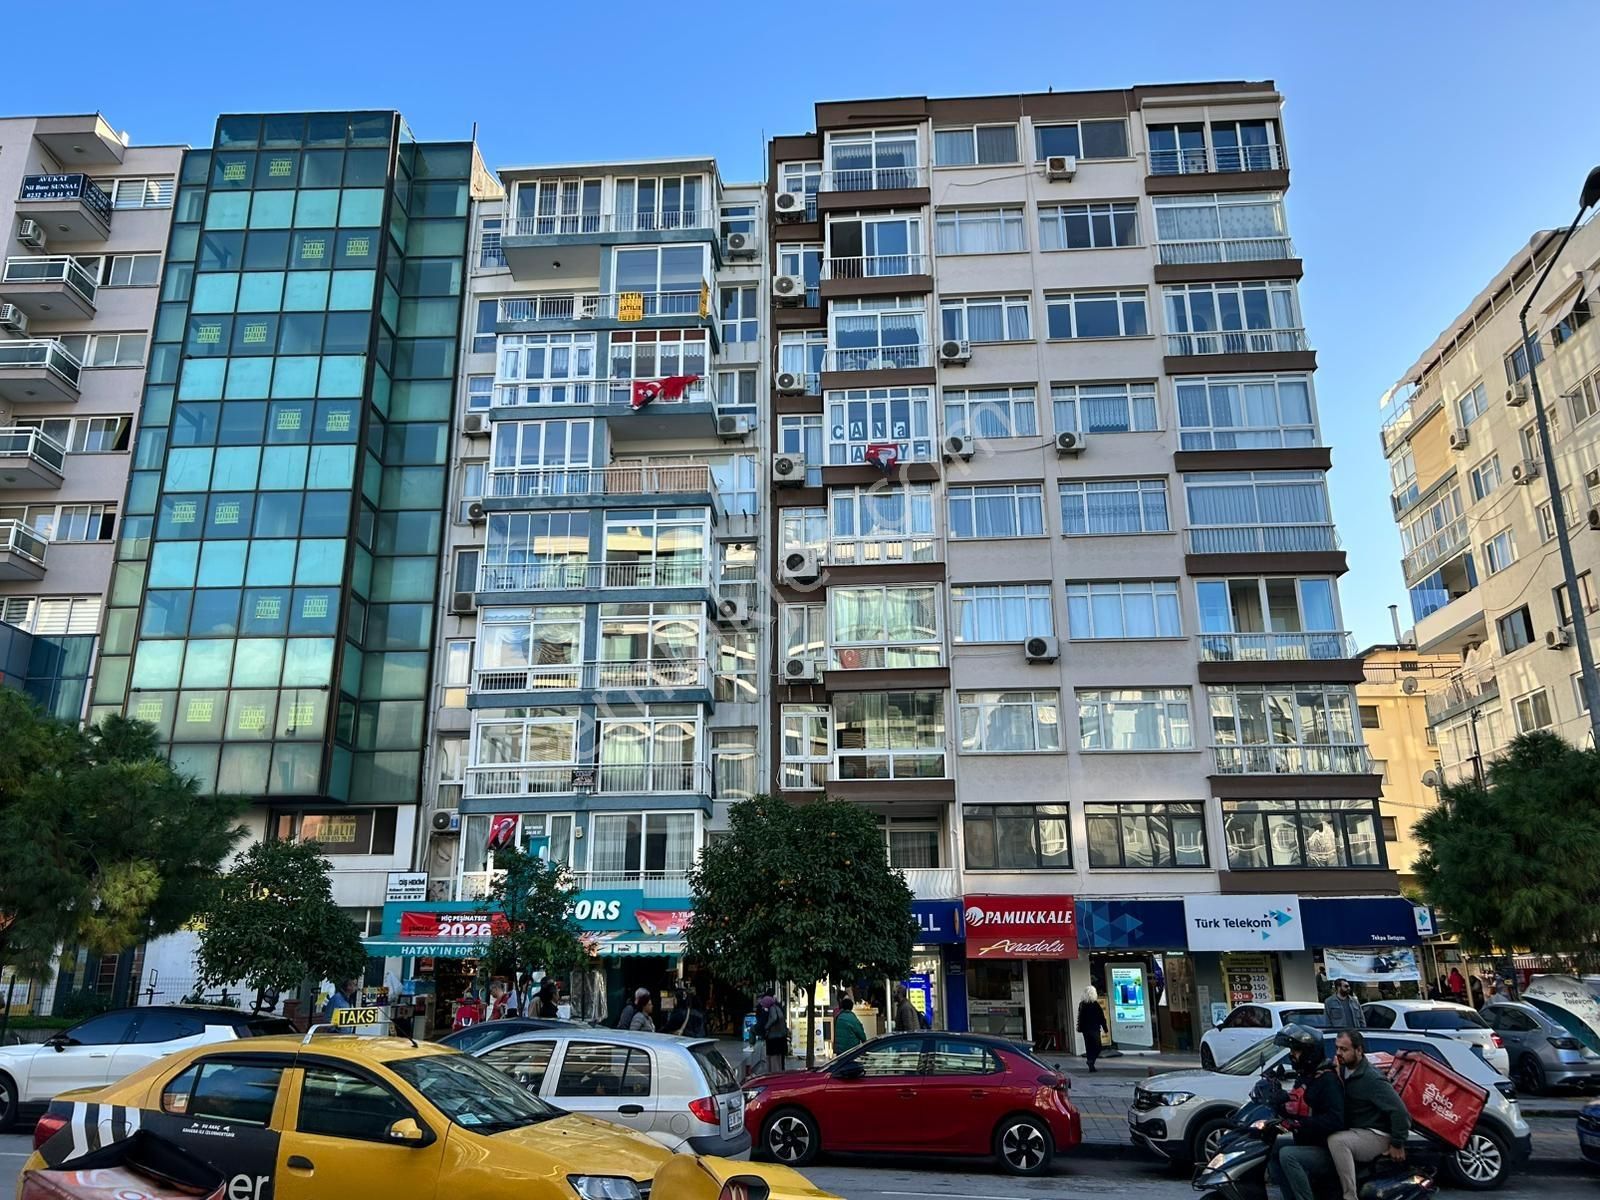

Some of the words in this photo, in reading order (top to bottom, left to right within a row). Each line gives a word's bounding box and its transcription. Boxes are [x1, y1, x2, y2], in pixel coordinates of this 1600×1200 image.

[985, 910, 1072, 924] PAMUKKALE
[1194, 918, 1220, 928] Türk
[1222, 918, 1271, 928] Telekom
[438, 923, 492, 936] 2026
[401, 946, 452, 955] HATAY'IN
[979, 939, 1064, 956] Anadolu
